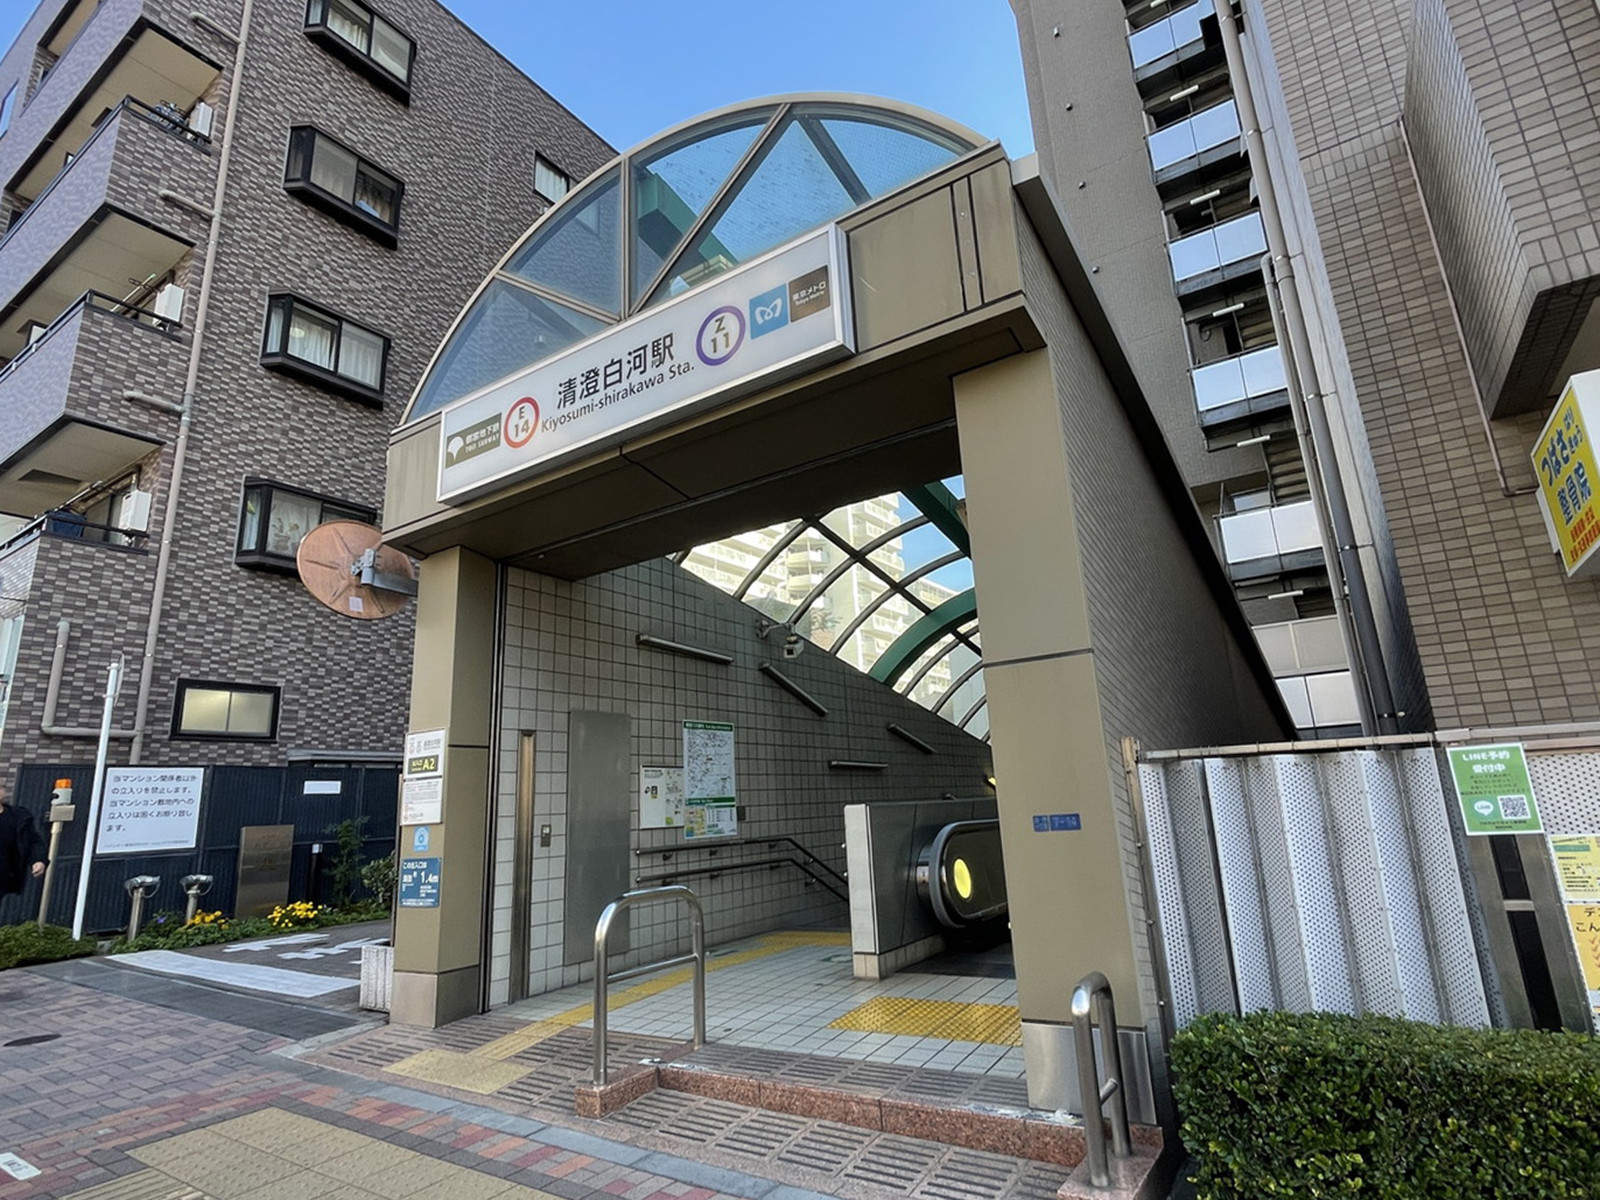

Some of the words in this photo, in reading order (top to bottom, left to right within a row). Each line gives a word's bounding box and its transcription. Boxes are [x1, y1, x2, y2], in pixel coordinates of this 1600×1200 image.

[714, 315, 726, 333] Z
[710, 331, 731, 354] 11
[556, 332, 675, 410] 清澄白河駅
[541, 372, 664, 433] Kiyosumi-shirakawa
[668, 360, 695, 380] Sta.
[518, 405, 525, 420] E
[513, 419, 530, 438] 14
[1541, 429, 1570, 487] つばさ
[1557, 460, 1592, 526] 整骨院
[422, 758, 436, 771] A2
[1462, 750, 1510, 761] LINE予約
